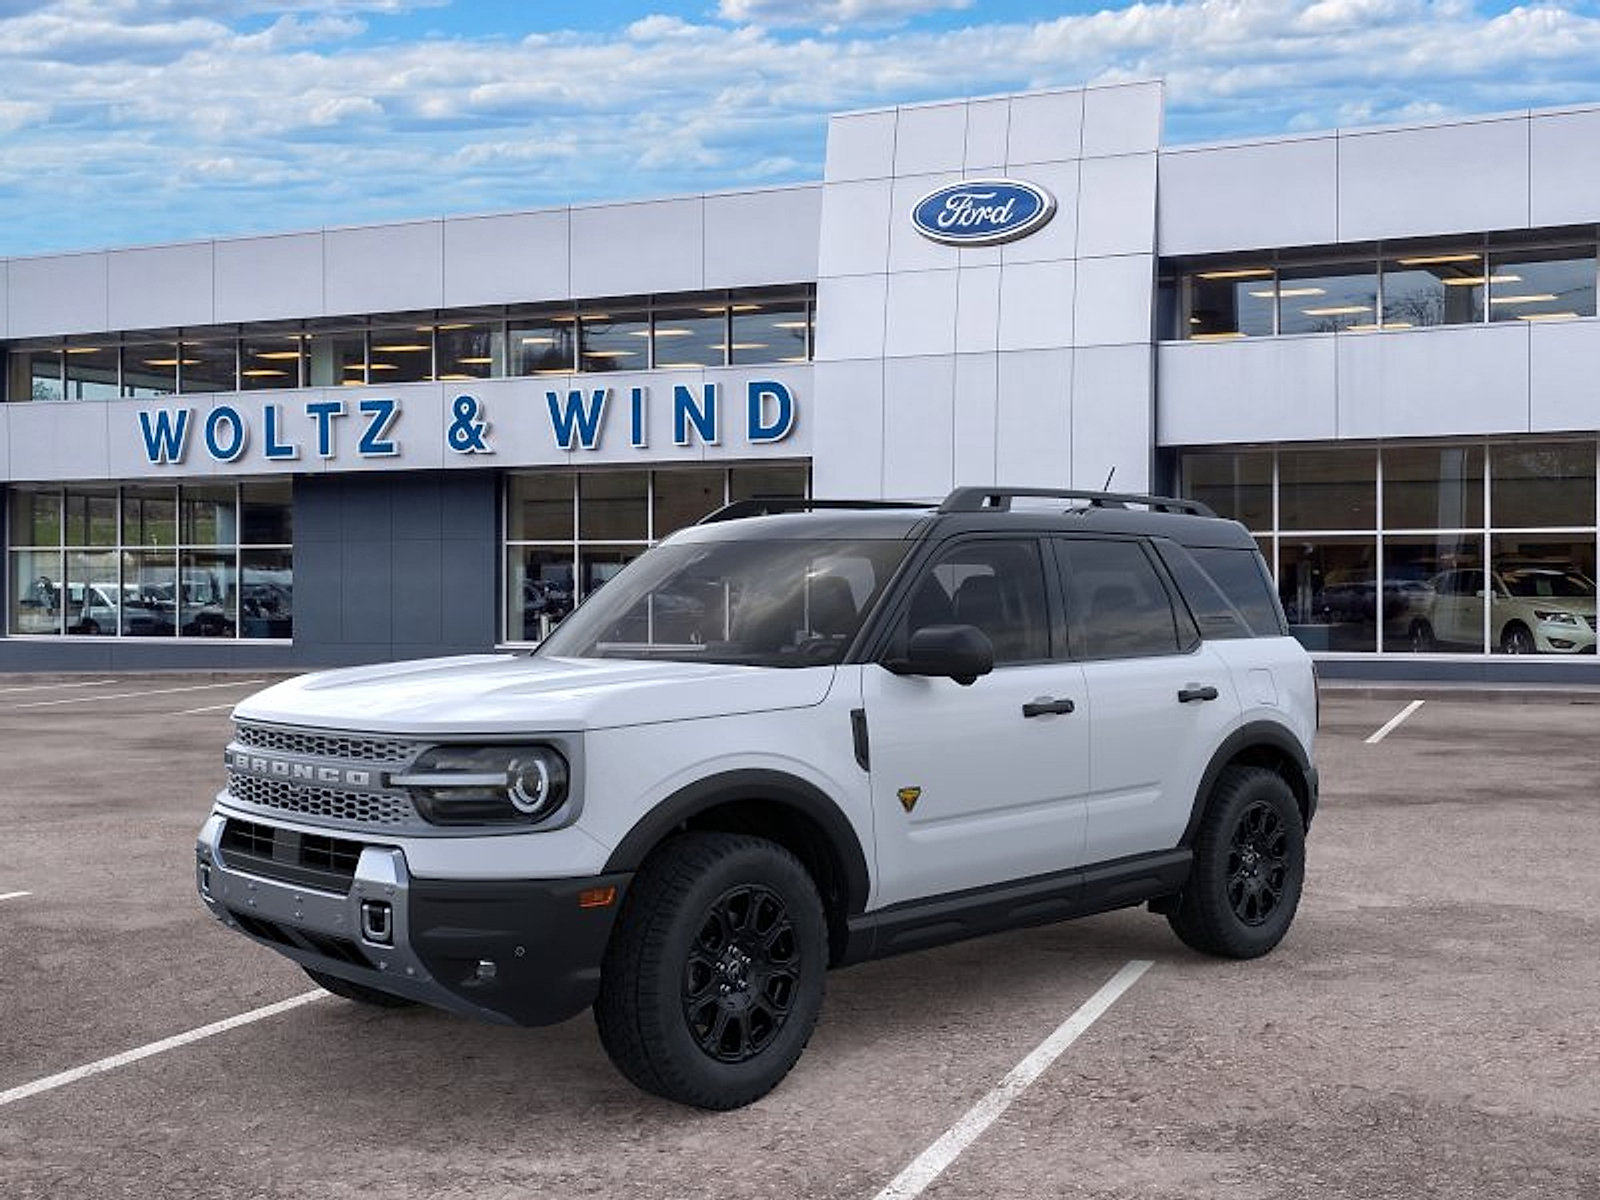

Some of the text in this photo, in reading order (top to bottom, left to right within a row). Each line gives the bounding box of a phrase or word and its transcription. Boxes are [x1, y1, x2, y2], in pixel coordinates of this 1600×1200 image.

[938, 192, 1015, 227] Ford
[138, 381, 796, 463] WOLTZ & WIND
[235, 755, 370, 785] BRONCO
